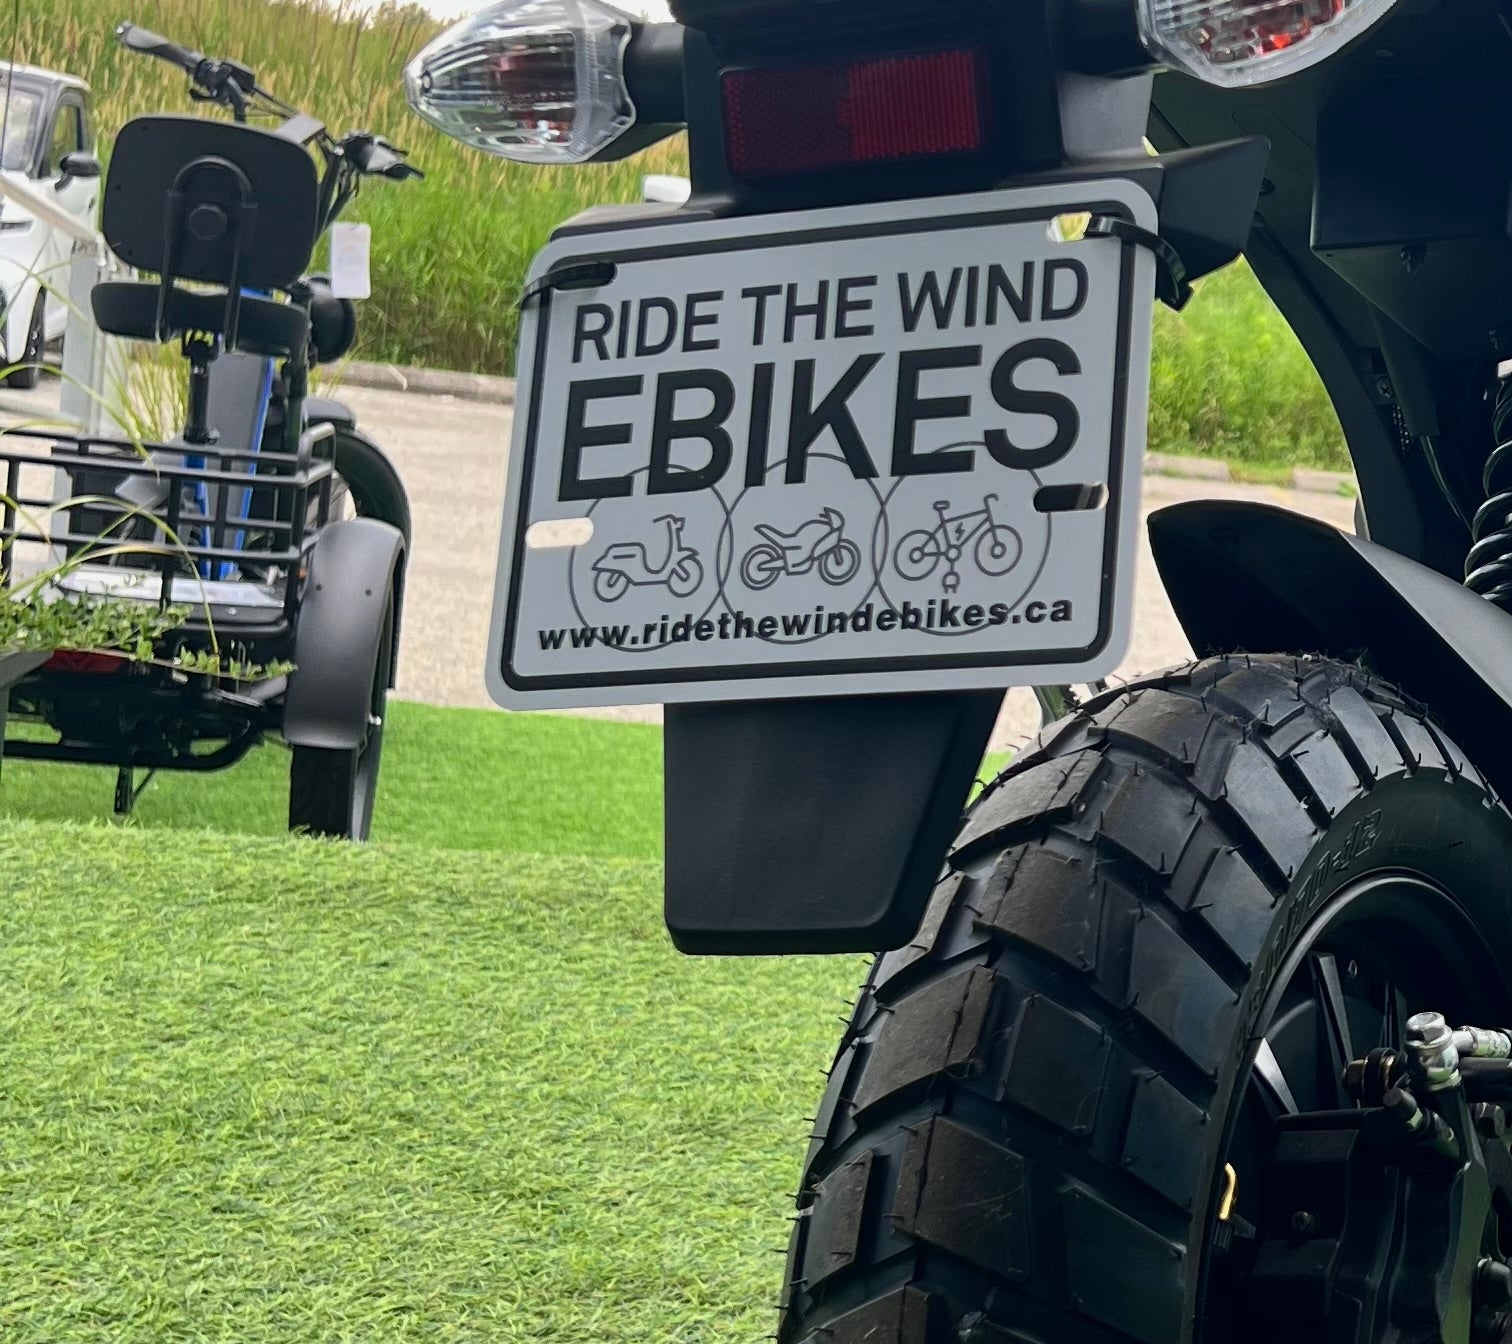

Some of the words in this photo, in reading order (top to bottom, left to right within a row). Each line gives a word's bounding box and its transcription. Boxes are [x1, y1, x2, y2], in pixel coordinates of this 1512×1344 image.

[571, 290, 724, 364] RIDE
[741, 274, 879, 347] THE
[897, 257, 1090, 333] WIND
[557, 337, 1084, 503] EBIKES
[537, 596, 1074, 652] www.ridethewindebikes.ca
